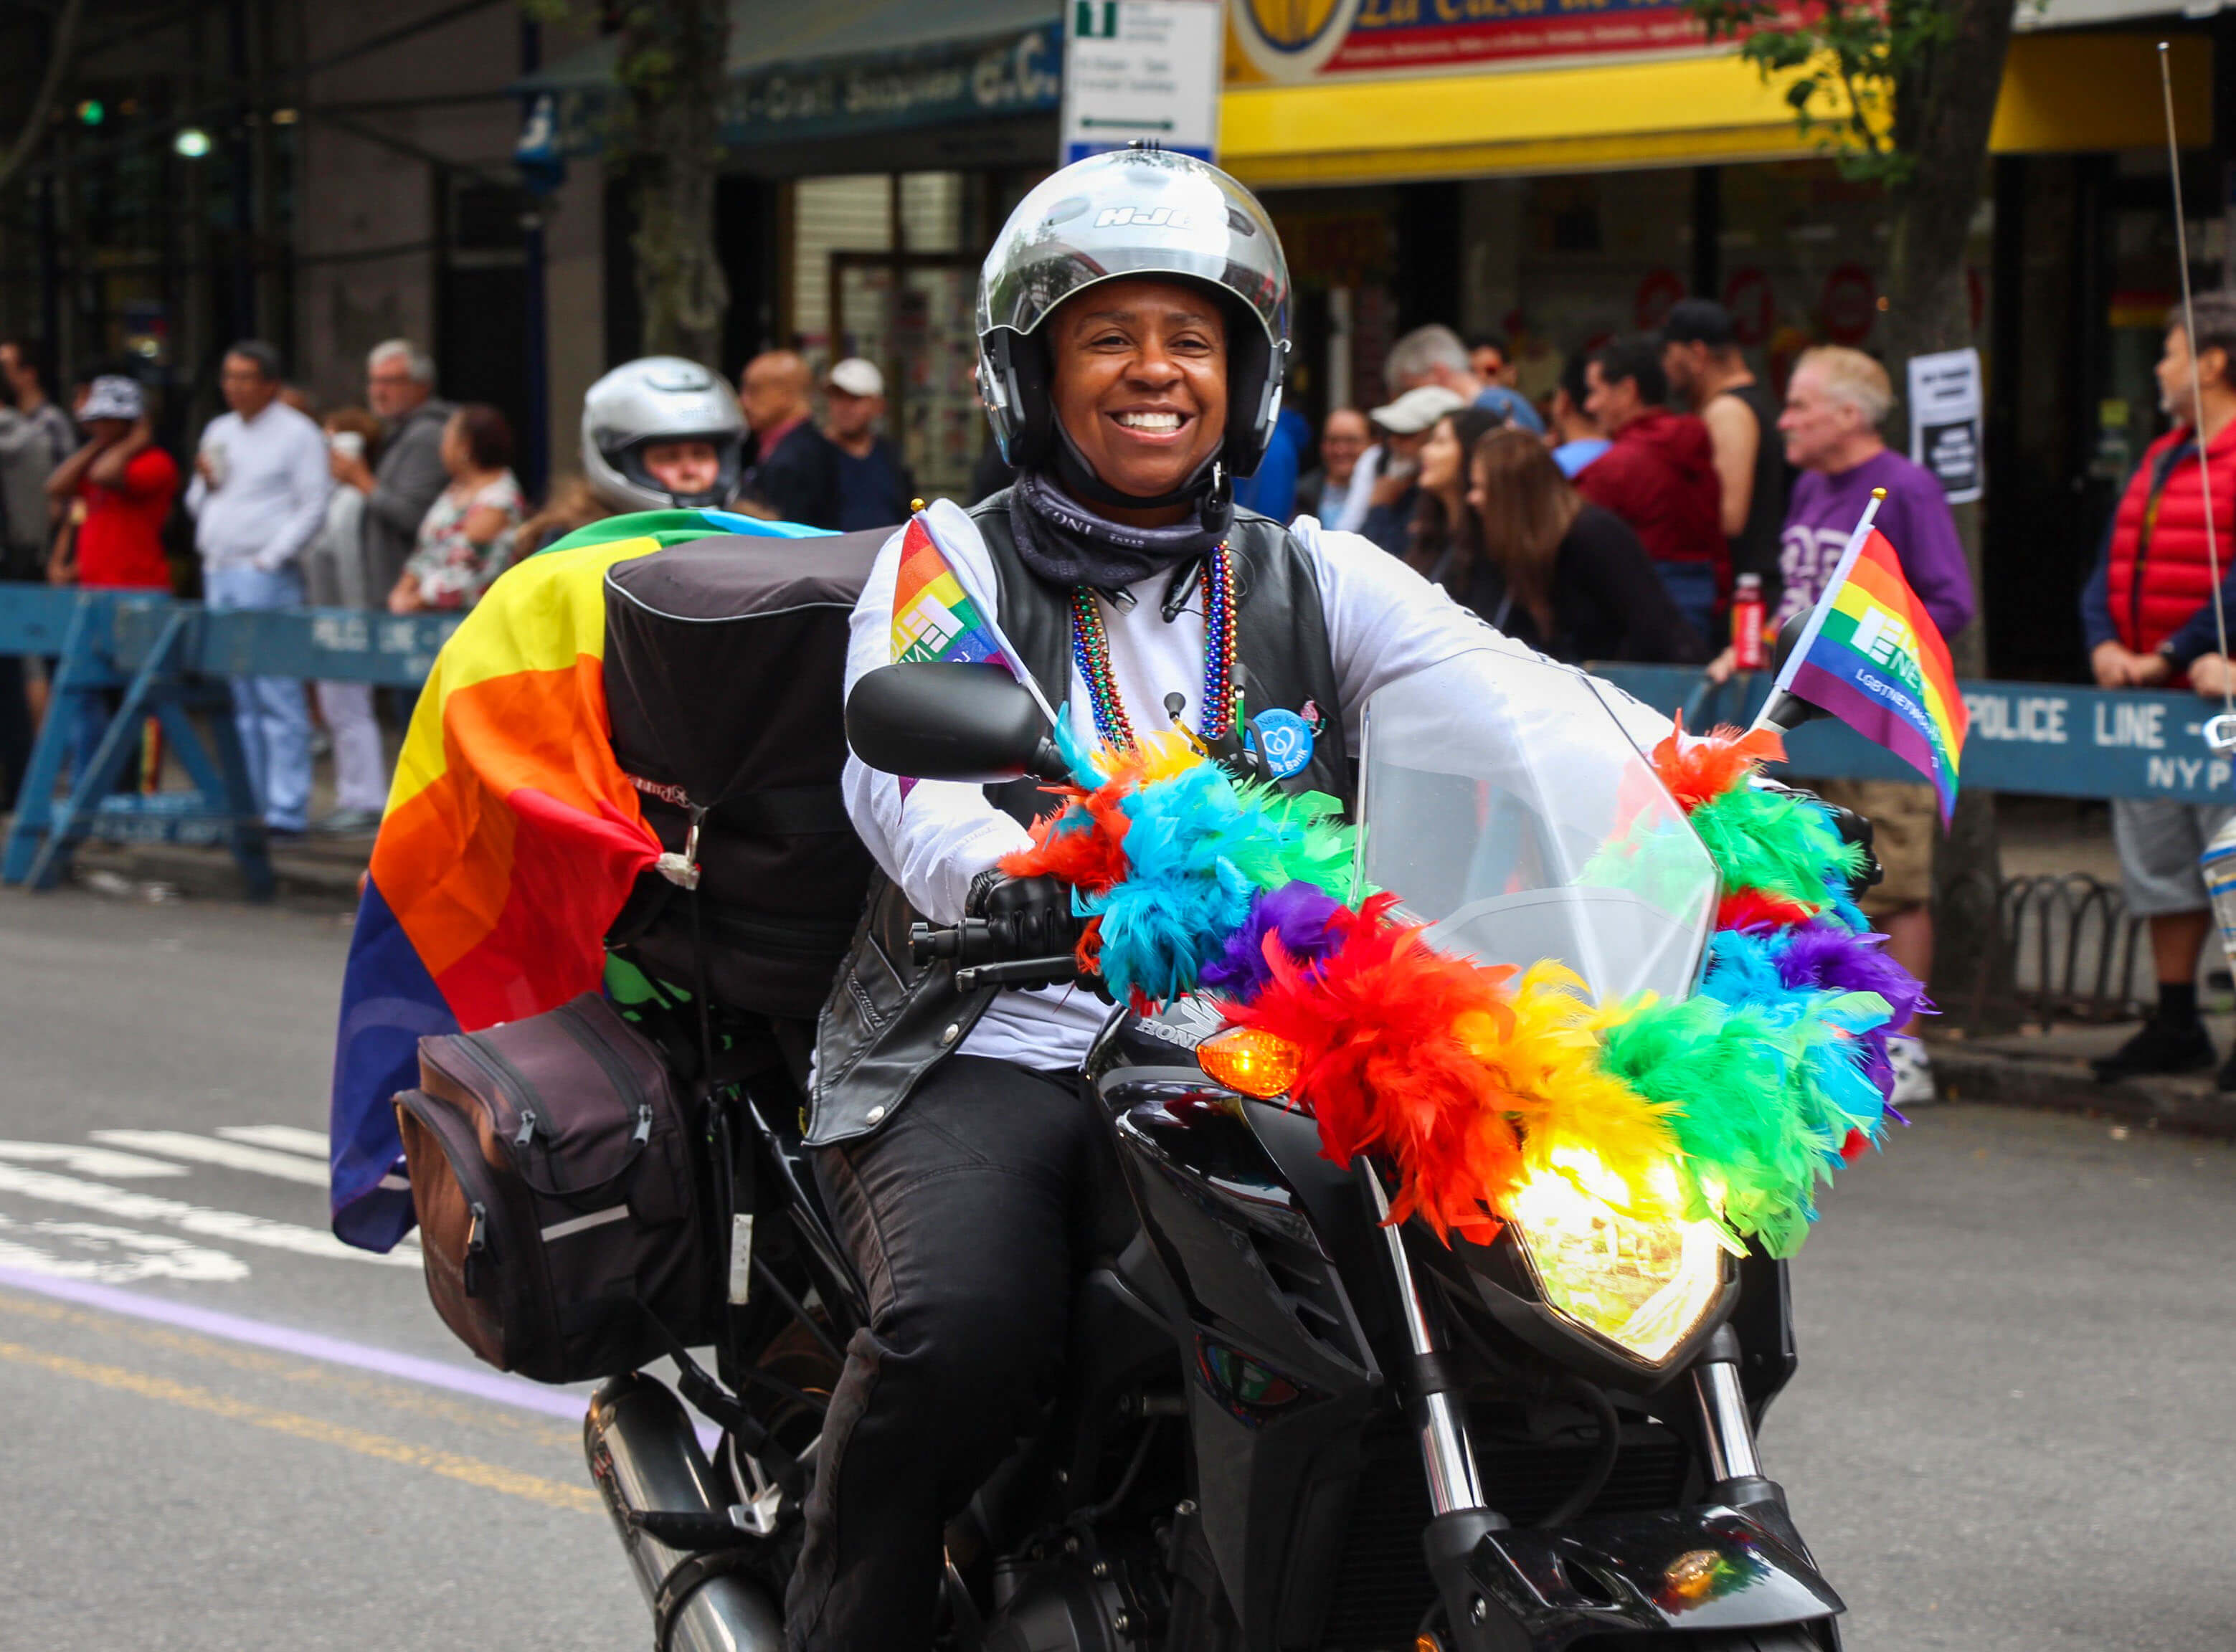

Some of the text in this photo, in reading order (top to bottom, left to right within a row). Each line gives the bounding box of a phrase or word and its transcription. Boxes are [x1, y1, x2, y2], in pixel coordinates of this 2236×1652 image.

[1963, 693, 2068, 744] POLICE
[2095, 701, 2166, 750] LINE
[1284, 748, 1309, 771] Bank
[2148, 755, 2232, 792] NYP
[1134, 1017, 1203, 1052] HON
